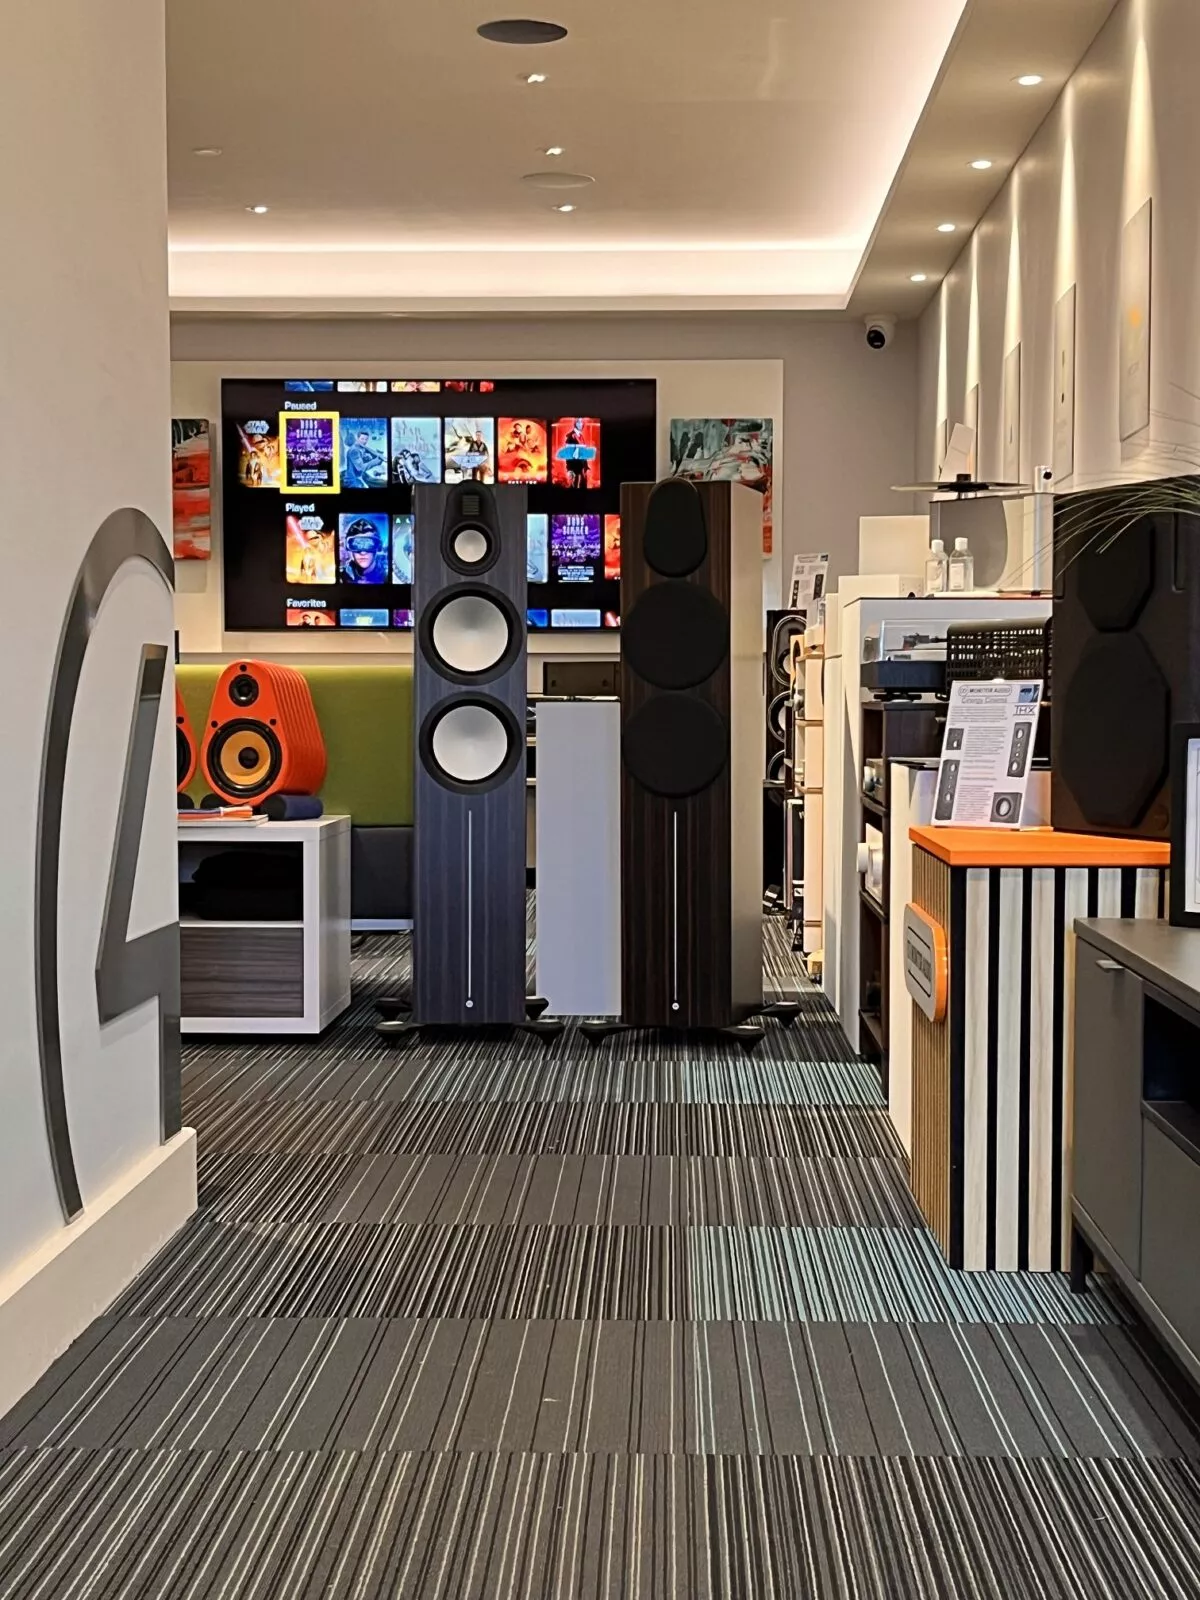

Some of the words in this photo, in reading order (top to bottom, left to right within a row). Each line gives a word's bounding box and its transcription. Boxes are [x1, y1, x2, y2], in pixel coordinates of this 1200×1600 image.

[284, 401, 317, 411] Paused
[285, 502, 315, 514] Played
[286, 598, 327, 608] Favorites
[1013, 704, 1037, 716] THX
